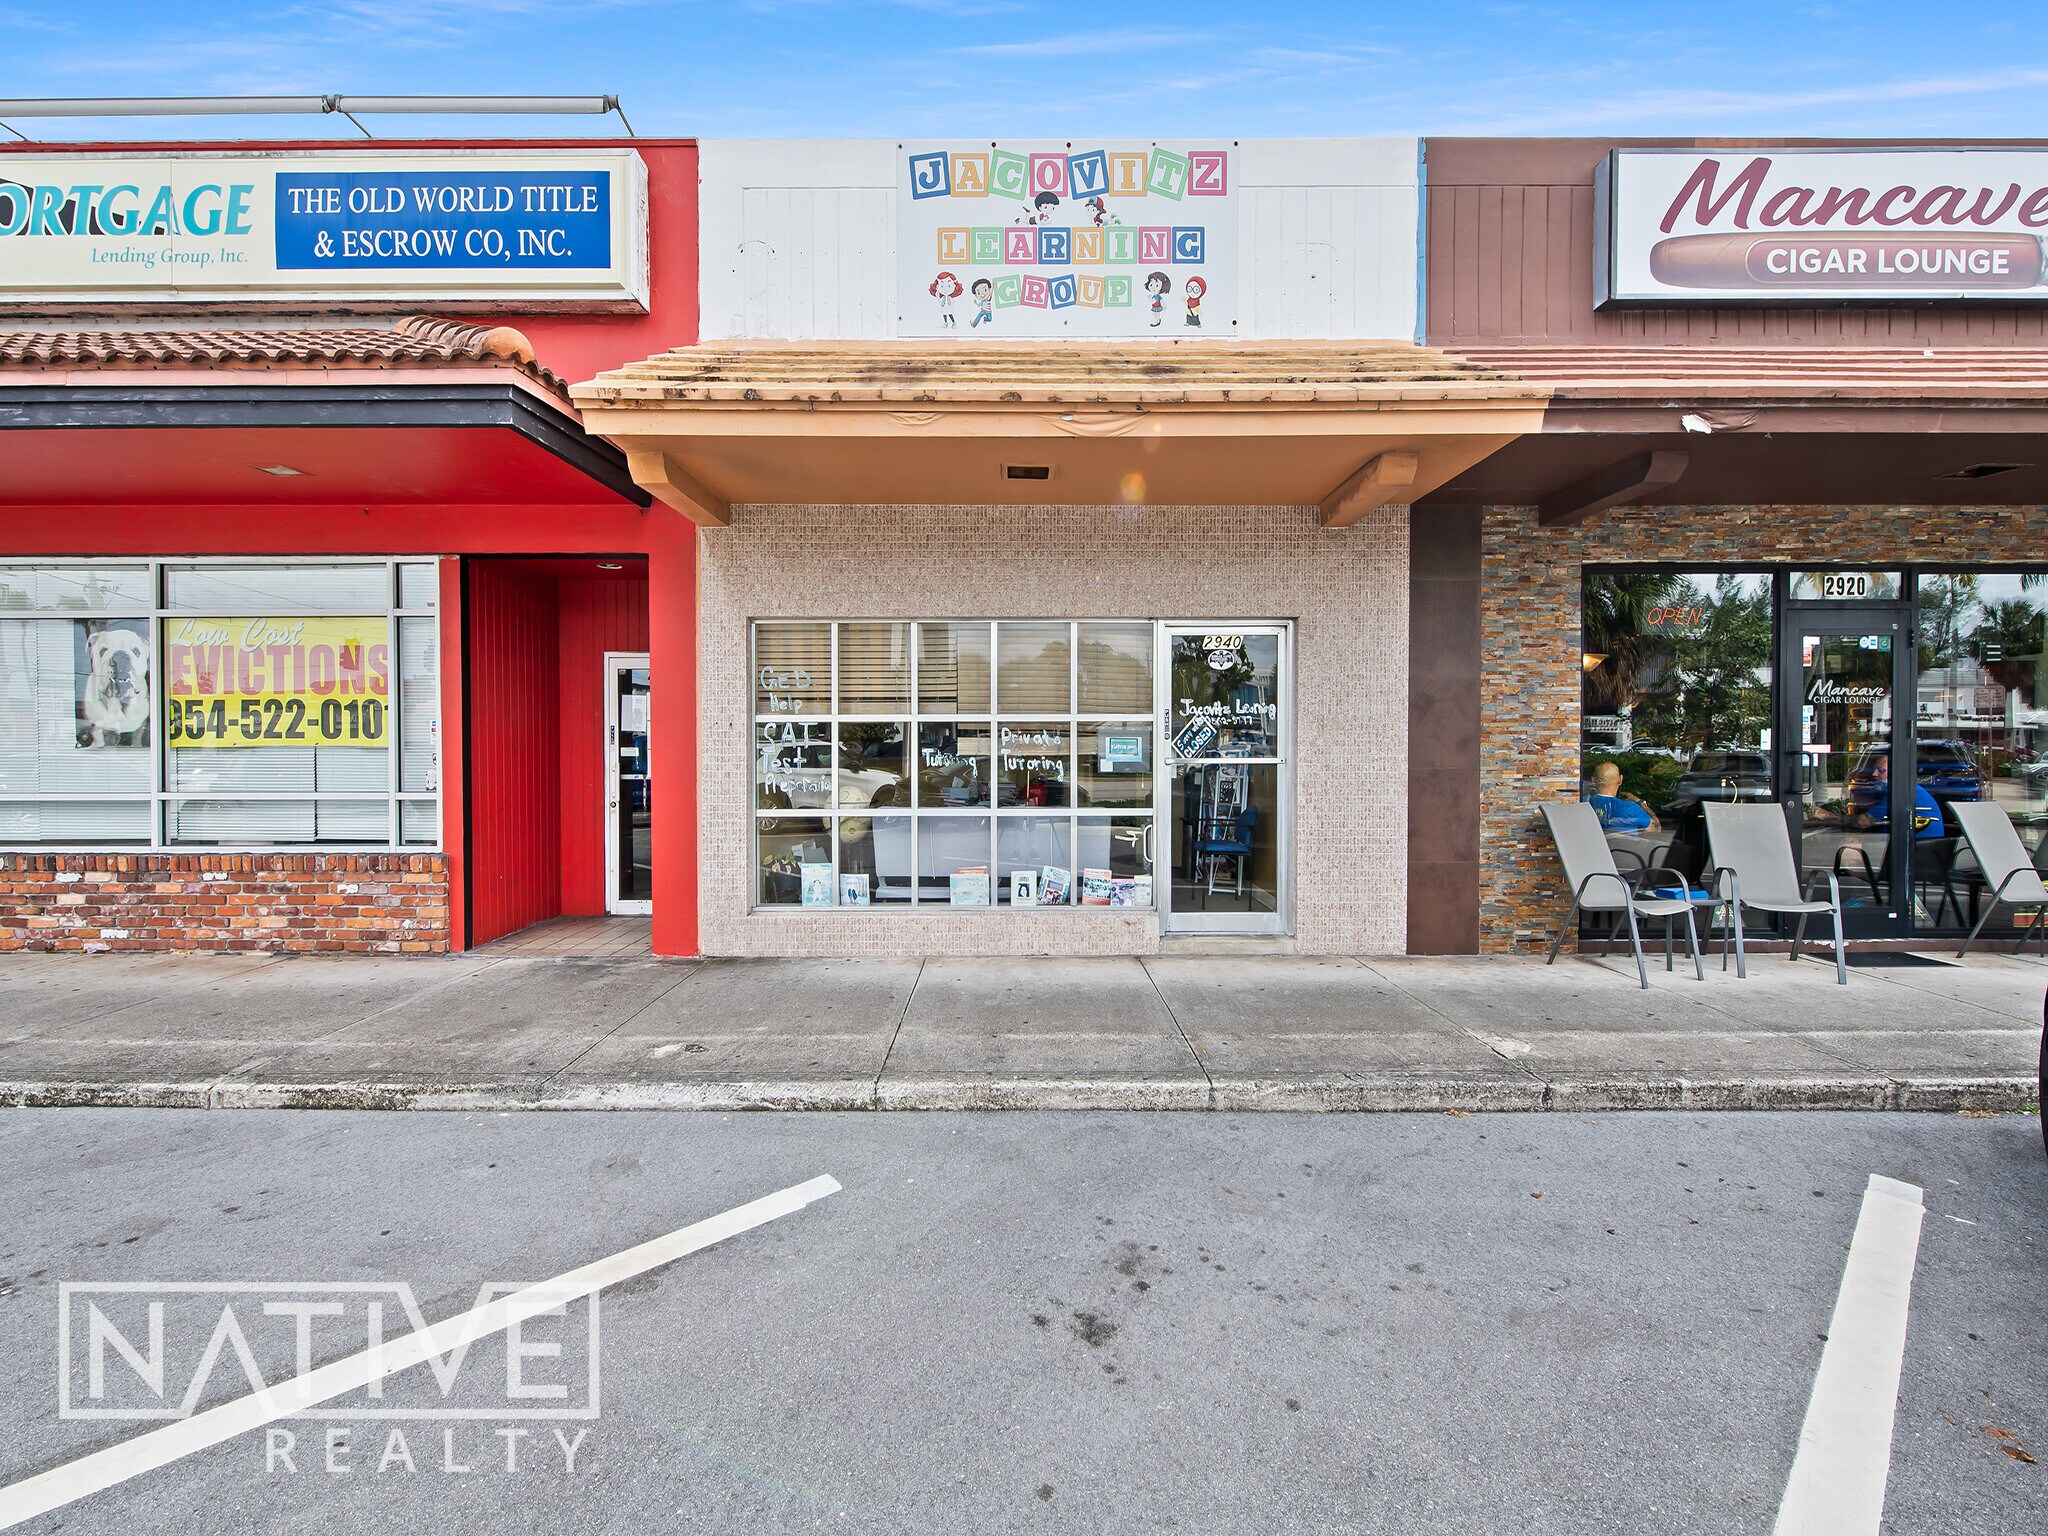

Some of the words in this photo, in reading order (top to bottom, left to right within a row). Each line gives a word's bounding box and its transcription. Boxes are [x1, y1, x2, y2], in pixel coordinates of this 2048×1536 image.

[913, 153, 1222, 196] JACOVITZ
[288, 187, 341, 214] THE
[349, 187, 405, 214] OLD
[412, 186, 513, 213] WORLD
[520, 186, 598, 212] TITLE
[1660, 157, 2048, 234] Mancave
[92, 247, 157, 269] Lending
[161, 247, 214, 269] Group,
[220, 247, 248, 263] Inc.
[313, 230, 336, 258] &
[342, 229, 457, 257] ESCROW
[465, 229, 511, 261] CO,
[518, 229, 572, 256] INC.
[939, 230, 1203, 261] LEARNING
[1766, 248, 1867, 274] CIGAR
[1878, 248, 2010, 274] LOUNGE
[995, 276, 1129, 306] GROUP
[1825, 576, 1867, 596] 2920
[1647, 607, 1703, 625] OPEN
[170, 618, 229, 647] Low
[241, 617, 304, 652] Cost
[1204, 635, 1241, 648] 2940
[172, 644, 388, 696] EVICTIONS
[769, 692, 803, 714] Help
[1808, 679, 1885, 700] Mancave
[1813, 696, 1842, 704] CIGAR
[1844, 696, 1881, 704] LOUNGE
[170, 697, 388, 740] 954-522-010
[1179, 698, 1231, 717] Jacovitz
[763, 722, 818, 750] SAT
[1001, 727, 1061, 747] Private
[1184, 726, 1212, 758] CLOSED
[760, 747, 807, 774] Test
[1001, 749, 1064, 782] Tutoring
